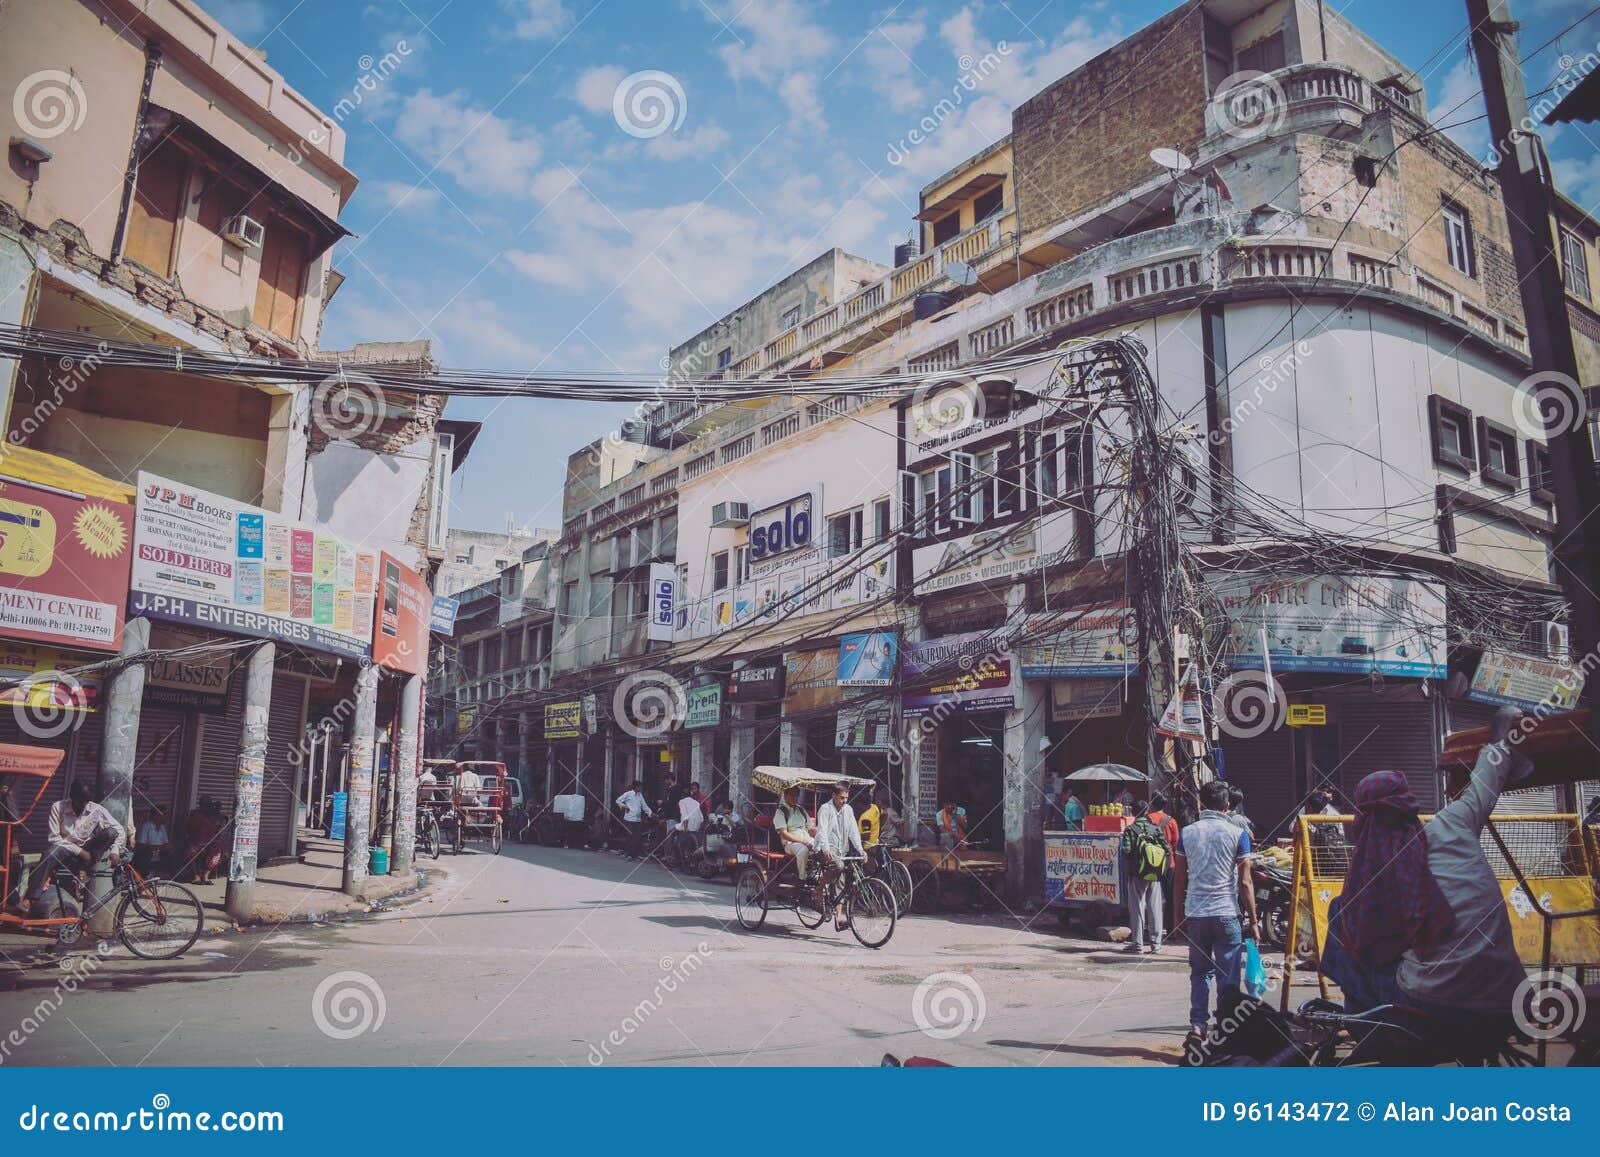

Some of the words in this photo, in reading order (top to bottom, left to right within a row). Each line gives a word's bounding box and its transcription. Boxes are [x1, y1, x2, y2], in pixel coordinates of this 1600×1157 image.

[918, 434, 949, 453] PREMIUM
[91, 513, 116, 538] Drink
[196, 501, 233, 521] BOOKS
[82, 520, 114, 549] Healthy
[752, 505, 810, 558] solo
[142, 545, 185, 567] SOLD
[189, 555, 232, 578] HERE
[921, 572, 972, 592] CALENDARS
[981, 558, 1026, 578] WEDDING
[48, 600, 102, 620] CENTRE
[135, 593, 190, 617] J.P.H.
[196, 603, 310, 641] ENTERPRISES
[657, 582, 673, 624] solo
[687, 691, 719, 713] Prem
